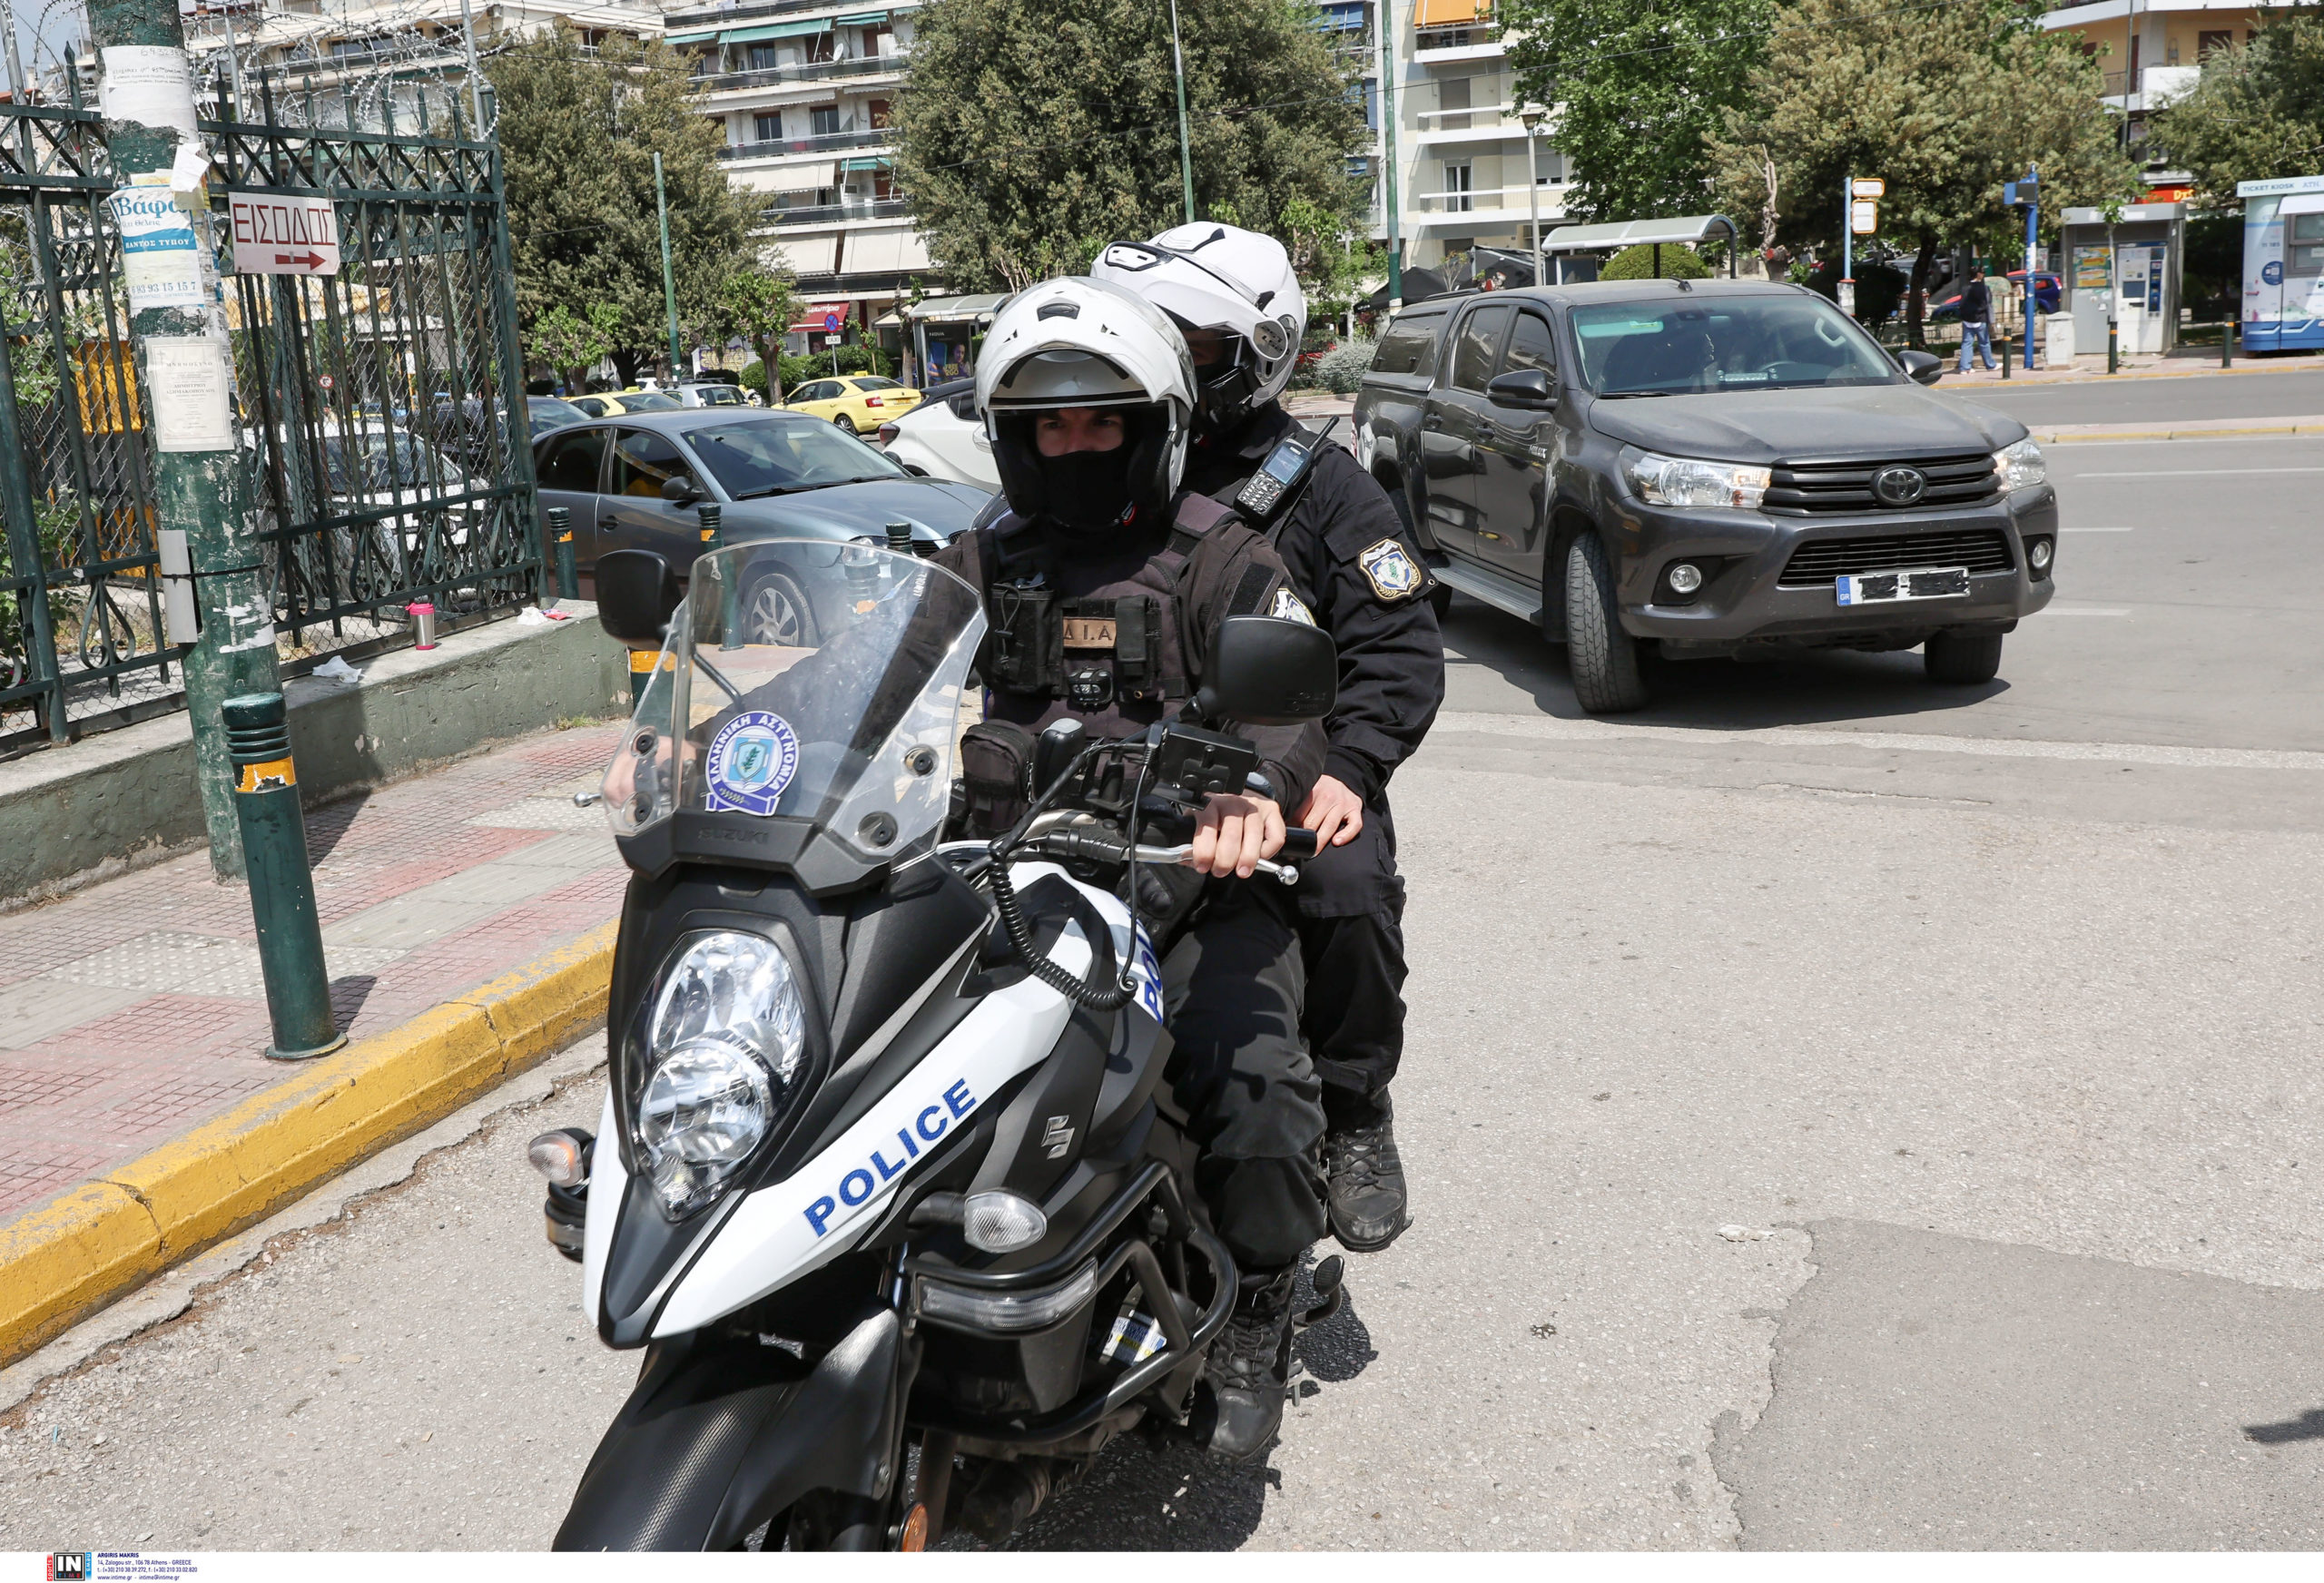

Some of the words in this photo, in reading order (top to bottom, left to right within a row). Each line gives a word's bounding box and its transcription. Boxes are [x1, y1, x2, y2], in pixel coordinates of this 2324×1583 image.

[233, 203, 336, 246] ΕΙΣΟΔΟΣ
[125, 240, 156, 249] ΠΑΝΤΟΣ
[159, 239, 190, 247] ΤΥΠΟΥ
[698, 827, 770, 845] SUZUKI
[803, 1077, 978, 1238] POLICE
